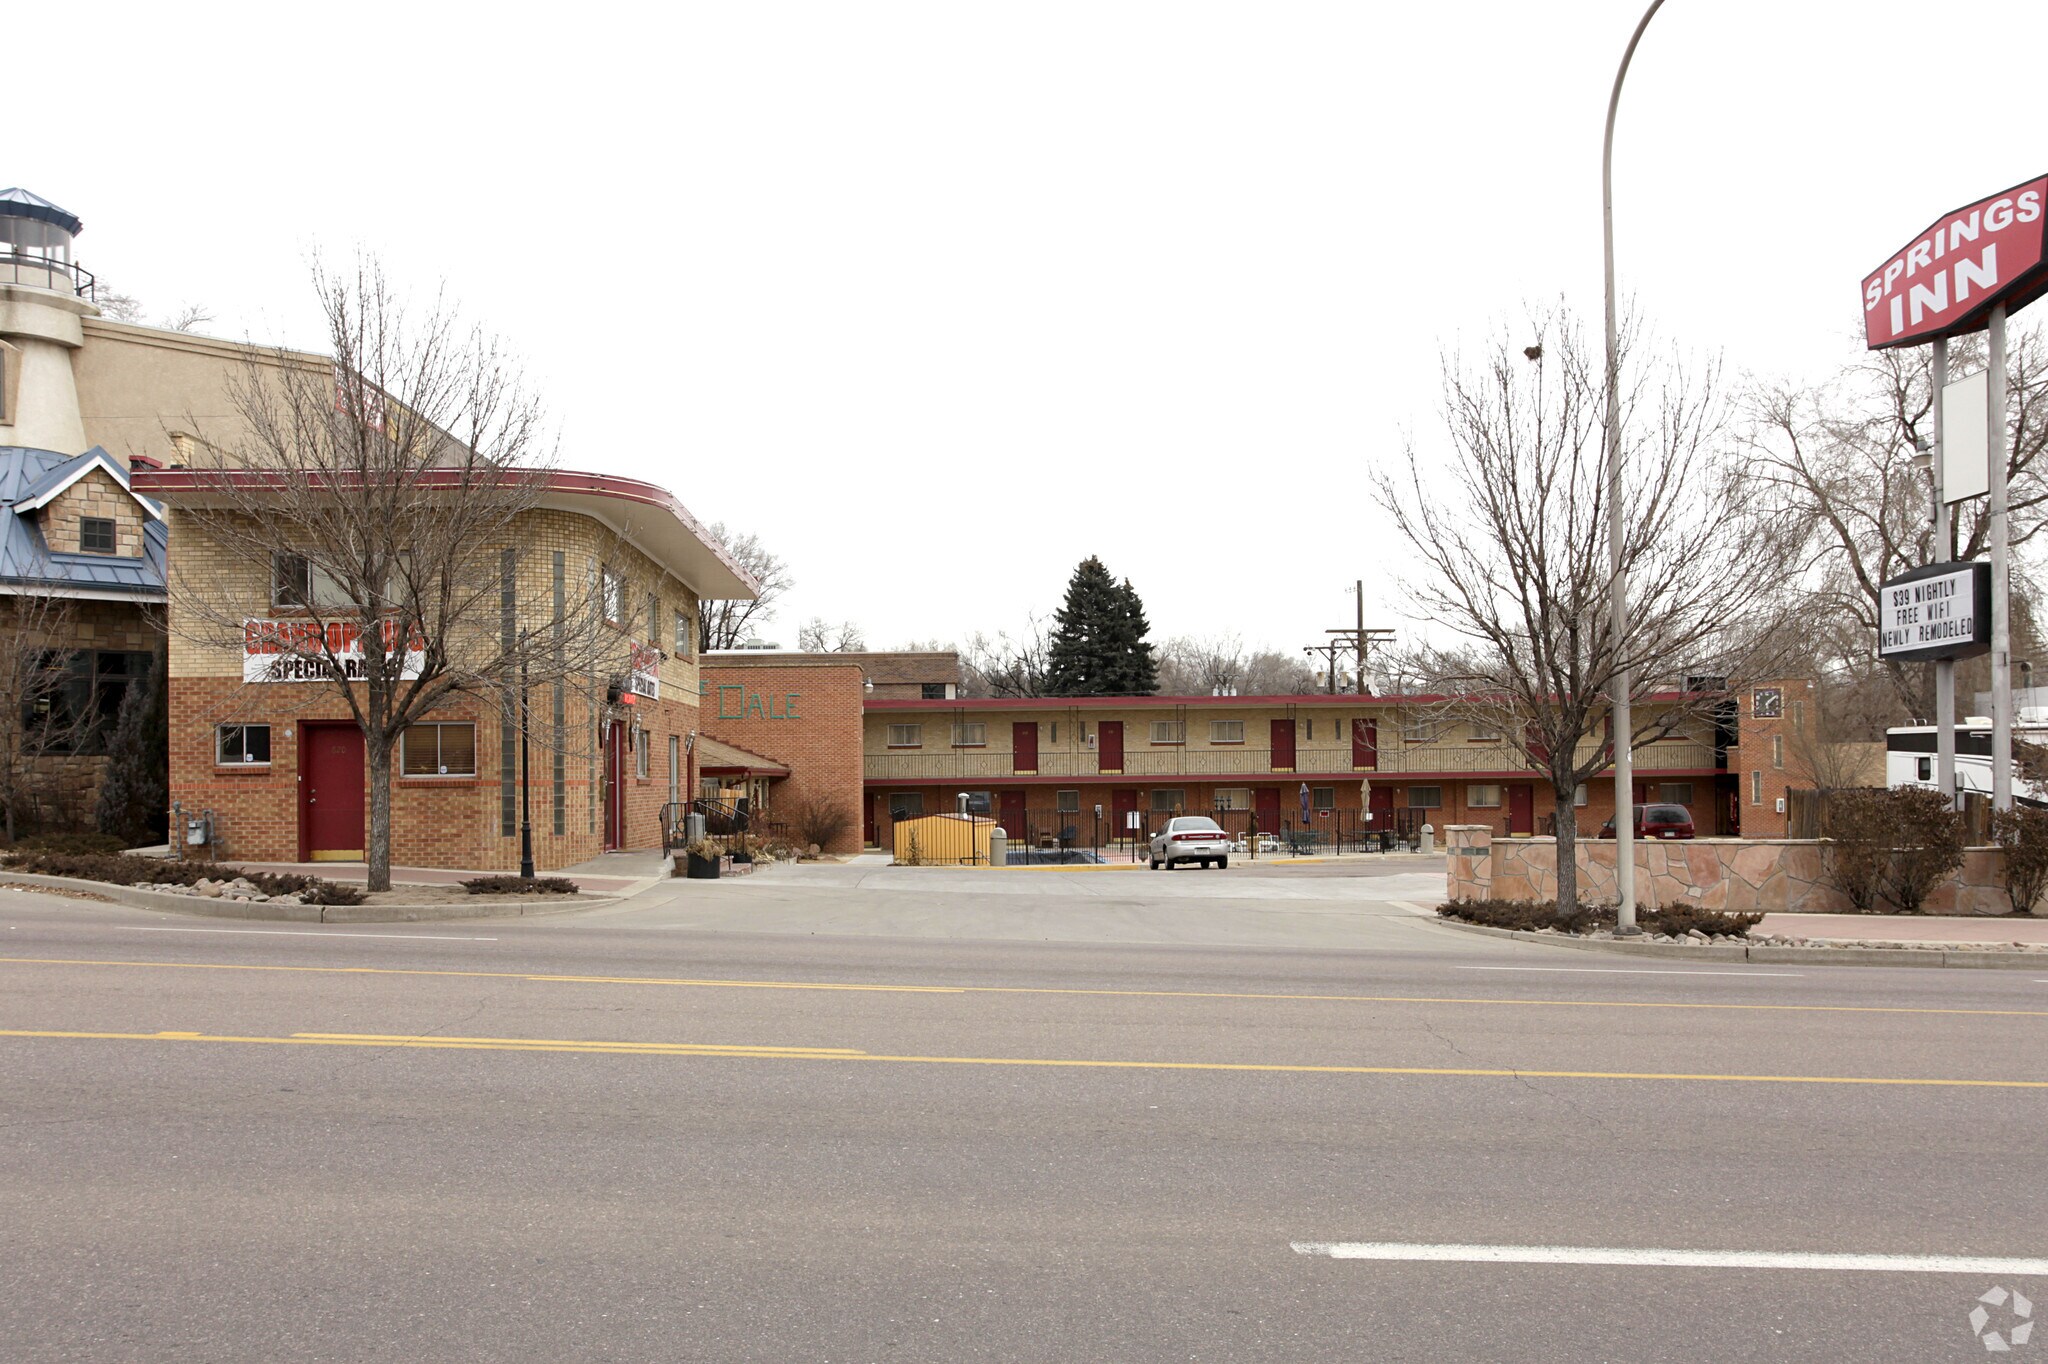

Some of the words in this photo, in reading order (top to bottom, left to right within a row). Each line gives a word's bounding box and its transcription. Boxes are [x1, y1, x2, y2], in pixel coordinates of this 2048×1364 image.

[1866, 191, 2040, 311] SPRINGS
[1890, 242, 1998, 336] INN
[1893, 589, 1910, 607] $39
[1915, 579, 1956, 603] NIGHTLY
[1897, 607, 1918, 626] FREE
[1927, 601, 1950, 620] WIFI
[1882, 628, 1910, 648] NEWLY
[1919, 617, 1973, 642] REMODELED
